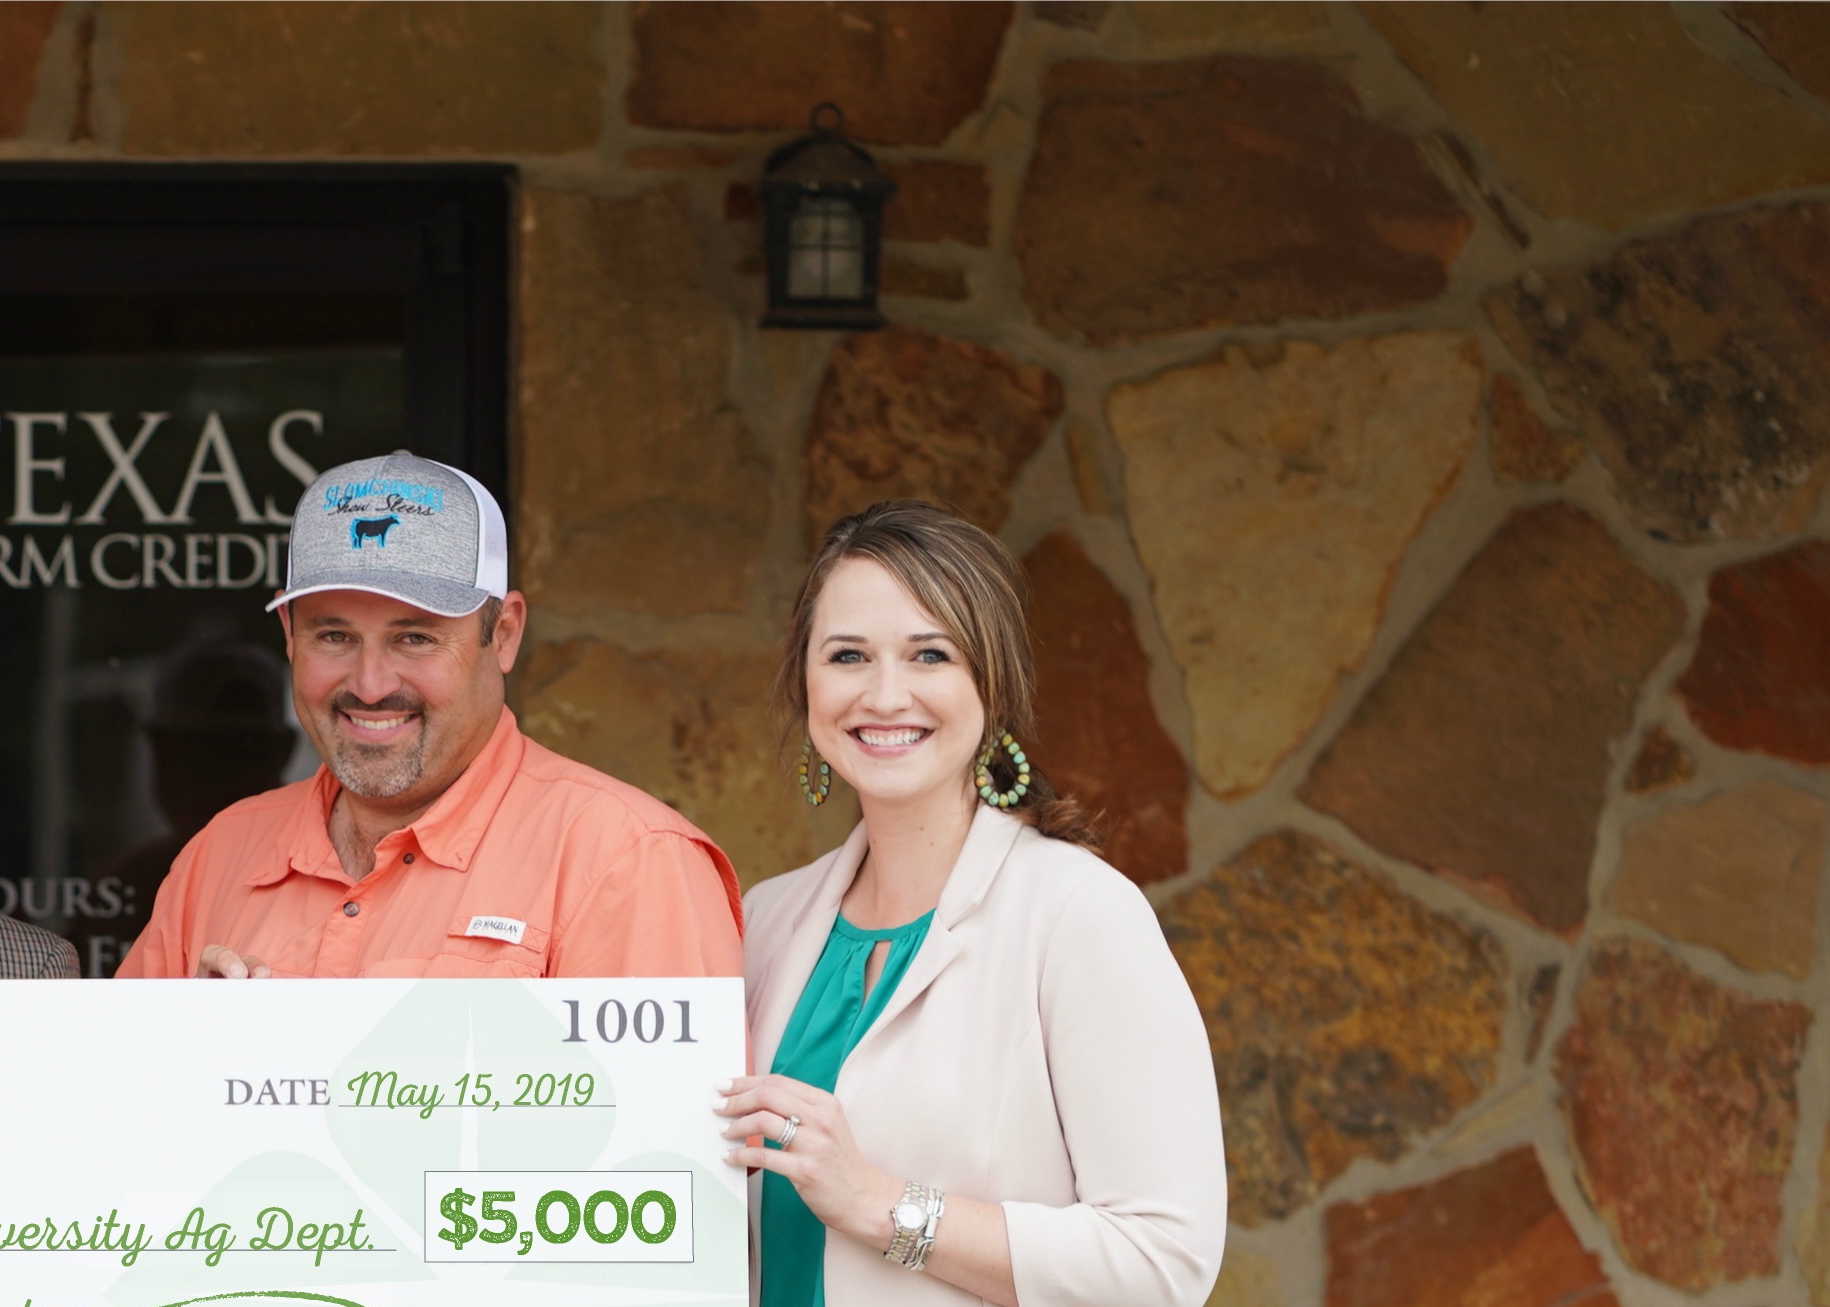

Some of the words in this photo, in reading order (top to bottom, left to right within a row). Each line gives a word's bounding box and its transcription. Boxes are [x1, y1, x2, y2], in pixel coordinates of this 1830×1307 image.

[323, 477, 444, 514] SLOMCHINSKI
[327, 496, 370, 516] Show
[374, 493, 436, 516] Steers
[90, 532, 290, 590] CREDI
[483, 920, 519, 934] MAGELLAN
[561, 998, 698, 1044] 1001
[223, 1078, 332, 1106] DATE
[347, 1071, 445, 1120] May
[454, 1072, 501, 1112] 15,
[513, 1072, 596, 1107] 2019
[164, 1206, 237, 1267] Ag
[248, 1206, 375, 1267] Dept.
[437, 1186, 678, 1257] $5,000
